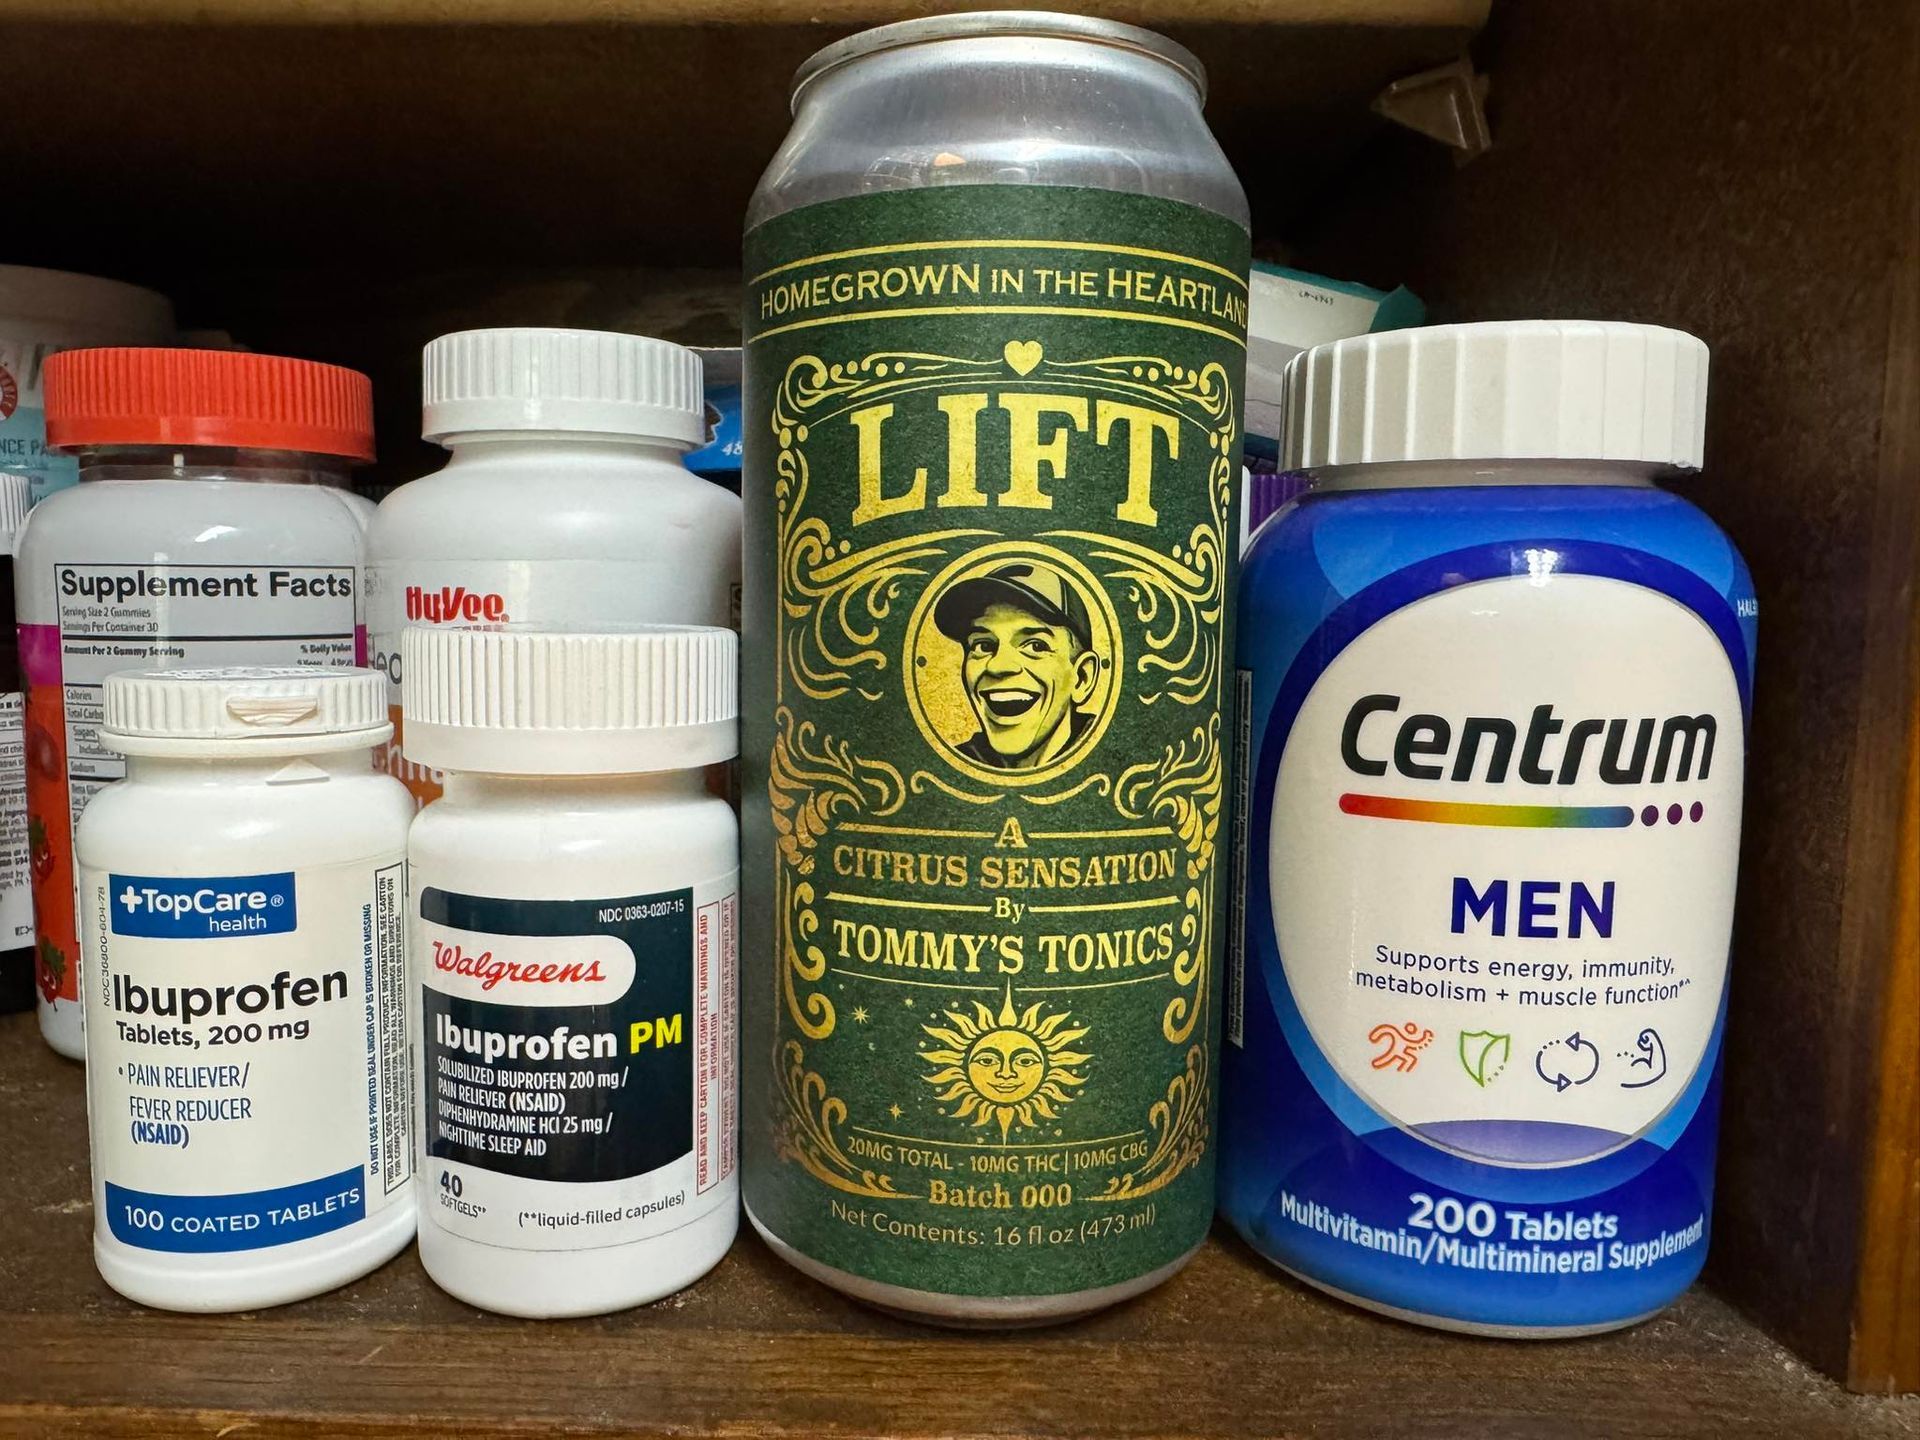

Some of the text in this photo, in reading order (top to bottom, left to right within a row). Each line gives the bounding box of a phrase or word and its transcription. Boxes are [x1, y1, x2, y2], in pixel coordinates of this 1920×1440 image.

[761, 264, 980, 319] HOMEGROWN
[991, 268, 1023, 294] IN
[1033, 268, 1099, 297] THE
[850, 392, 1180, 528] LIFT
[61, 569, 259, 603] Supplement
[269, 571, 351, 597] Facts
[62, 605, 151, 620] Serving Size 2 Gummies
[91, 622, 104, 633] Per
[105, 622, 145, 633] Container
[147, 622, 158, 633] 30
[92, 645, 105, 655] Per
[113, 646, 147, 658] Gummy
[149, 646, 185, 658] Serving
[66, 689, 92, 701] Calories
[67, 708, 83, 719] Total
[1341, 693, 1717, 785] Centrum
[995, 817, 1028, 848] A
[833, 845, 1177, 889] CITRUS SENSATION
[209, 914, 267, 932] health
[363, 904, 372, 941] MISSING
[599, 900, 684, 923] NDC 0363-0207-15
[995, 897, 1025, 924] By
[1451, 877, 1615, 939] MEN
[364, 943, 373, 955] OR
[833, 919, 1174, 974] TOMMY'S TONICS
[1376, 945, 1675, 981] Supports energy, immunity,
[364, 957, 374, 993] BROKEN
[432, 941, 606, 990] Walgreens
[112, 970, 348, 1024] Ibuprofen
[365, 994, 374, 1002] IS
[1356, 972, 1486, 1003] metabolism
[1496, 988, 1510, 1002] +
[1519, 985, 1597, 1006] muscle
[366, 1005, 375, 1023] CAP
[116, 1020, 309, 1049] Tablets, 200 mg
[367, 1023, 376, 1053] UNDER
[436, 1013, 682, 1063] Ibuprofen PM
[700, 914, 708, 1186] READ AND KEEP CARTON FOR COMPLETE WARNINGS AND
[128, 1062, 250, 1089] PAIN RELIEVER/
[367, 1053, 377, 1075] SEAL
[438, 1056, 494, 1086] SOLUBILIZED
[497, 1068, 566, 1090] IBUPROFEN
[570, 1070, 594, 1089] 200
[130, 1096, 252, 1121] FEVER REDUCER
[368, 1078, 377, 1115] PRINTED
[438, 1077, 565, 1114] PAIN RELIEVER (NSAID)
[370, 1124, 378, 1141] USE
[438, 1100, 536, 1134] DIPHENHYDRAMINE
[563, 1115, 578, 1133] 25
[131, 1121, 190, 1149] (NSAID)
[370, 1143, 379, 1160] NOT
[438, 1121, 546, 1157] NIGHTTIME SLEEP AID
[370, 1160, 380, 1176] DO
[847, 1136, 893, 1161] 20MG
[898, 1146, 954, 1171] TOTAL
[970, 1155, 1019, 1174] 10MG
[1120, 1139, 1148, 1162] CBG
[440, 1170, 463, 1198] 40
[928, 1179, 1072, 1209] Batch 000
[125, 1188, 360, 1233] 100 COATED TABLETS
[626, 1190, 685, 1219] capsules)
[1408, 1192, 1618, 1241] 200 Tablets
[831, 1200, 1156, 1246] Net Contents: 16 fl oz (473 ml)
[1280, 1189, 1704, 1273] Multivitamin/Multimineral Supplement
